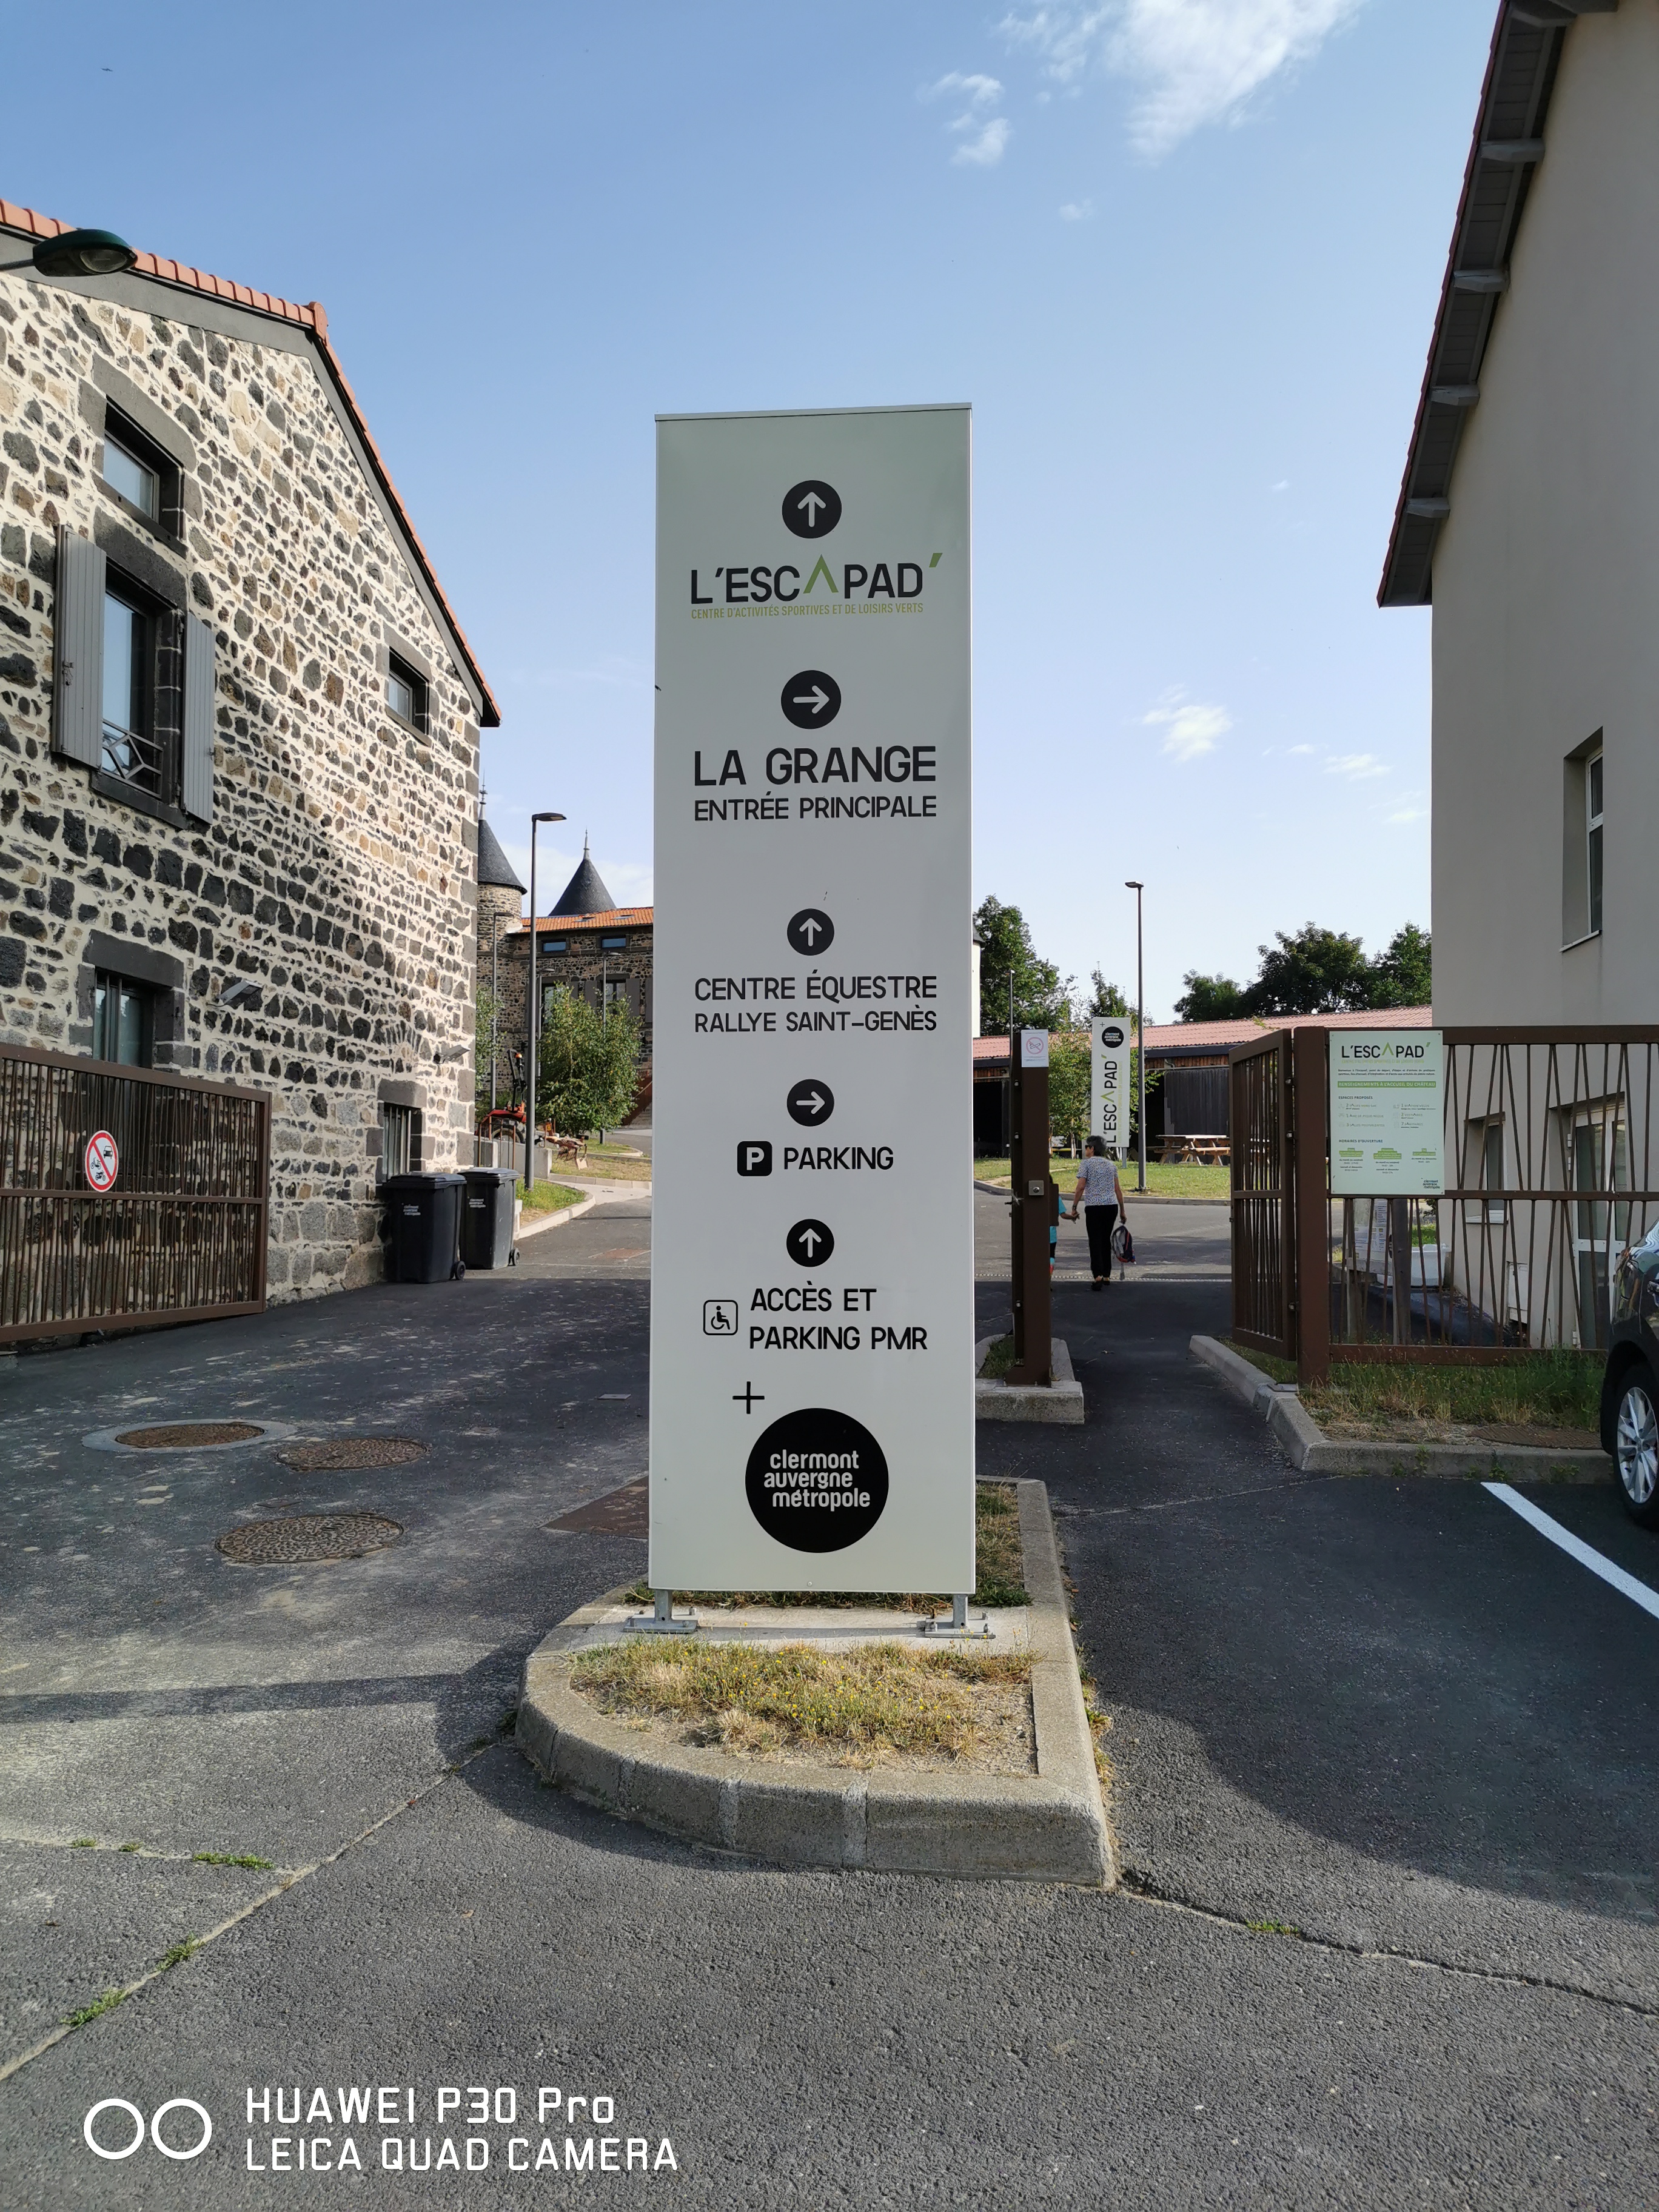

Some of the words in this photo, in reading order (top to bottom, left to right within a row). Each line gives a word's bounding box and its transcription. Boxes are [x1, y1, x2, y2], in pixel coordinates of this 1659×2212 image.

[691, 609, 725, 619] CENTRE
[728, 605, 779, 618] D'ACTIVITÉS
[782, 605, 830, 615] SPORTIVES
[832, 605, 842, 614] ET
[845, 604, 856, 614] DE
[859, 603, 893, 614] LOISIRS
[896, 603, 923, 613] VERTS
[695, 750, 746, 786] LA
[766, 746, 936, 785] GRANGE
[695, 791, 788, 821] ENTRÉE
[800, 796, 936, 819] PRINCIPALE
[695, 977, 795, 1000] CENTRE
[806, 969, 937, 1004] ÉQUESTRE
[695, 1013, 776, 1032] RALLYE
[786, 1004, 937, 1032] SAINT-GENÈS
[785, 1147, 893, 1170] PARKING
[751, 1281, 831, 1312] ACCÈS
[844, 1289, 877, 1311] ET
[750, 1326, 860, 1350] PARKING
[872, 1327, 927, 1349] PMR
[769, 1449, 859, 1469] clermont
[764, 1471, 853, 1489] auvergne
[772, 1488, 870, 1512] métropole
